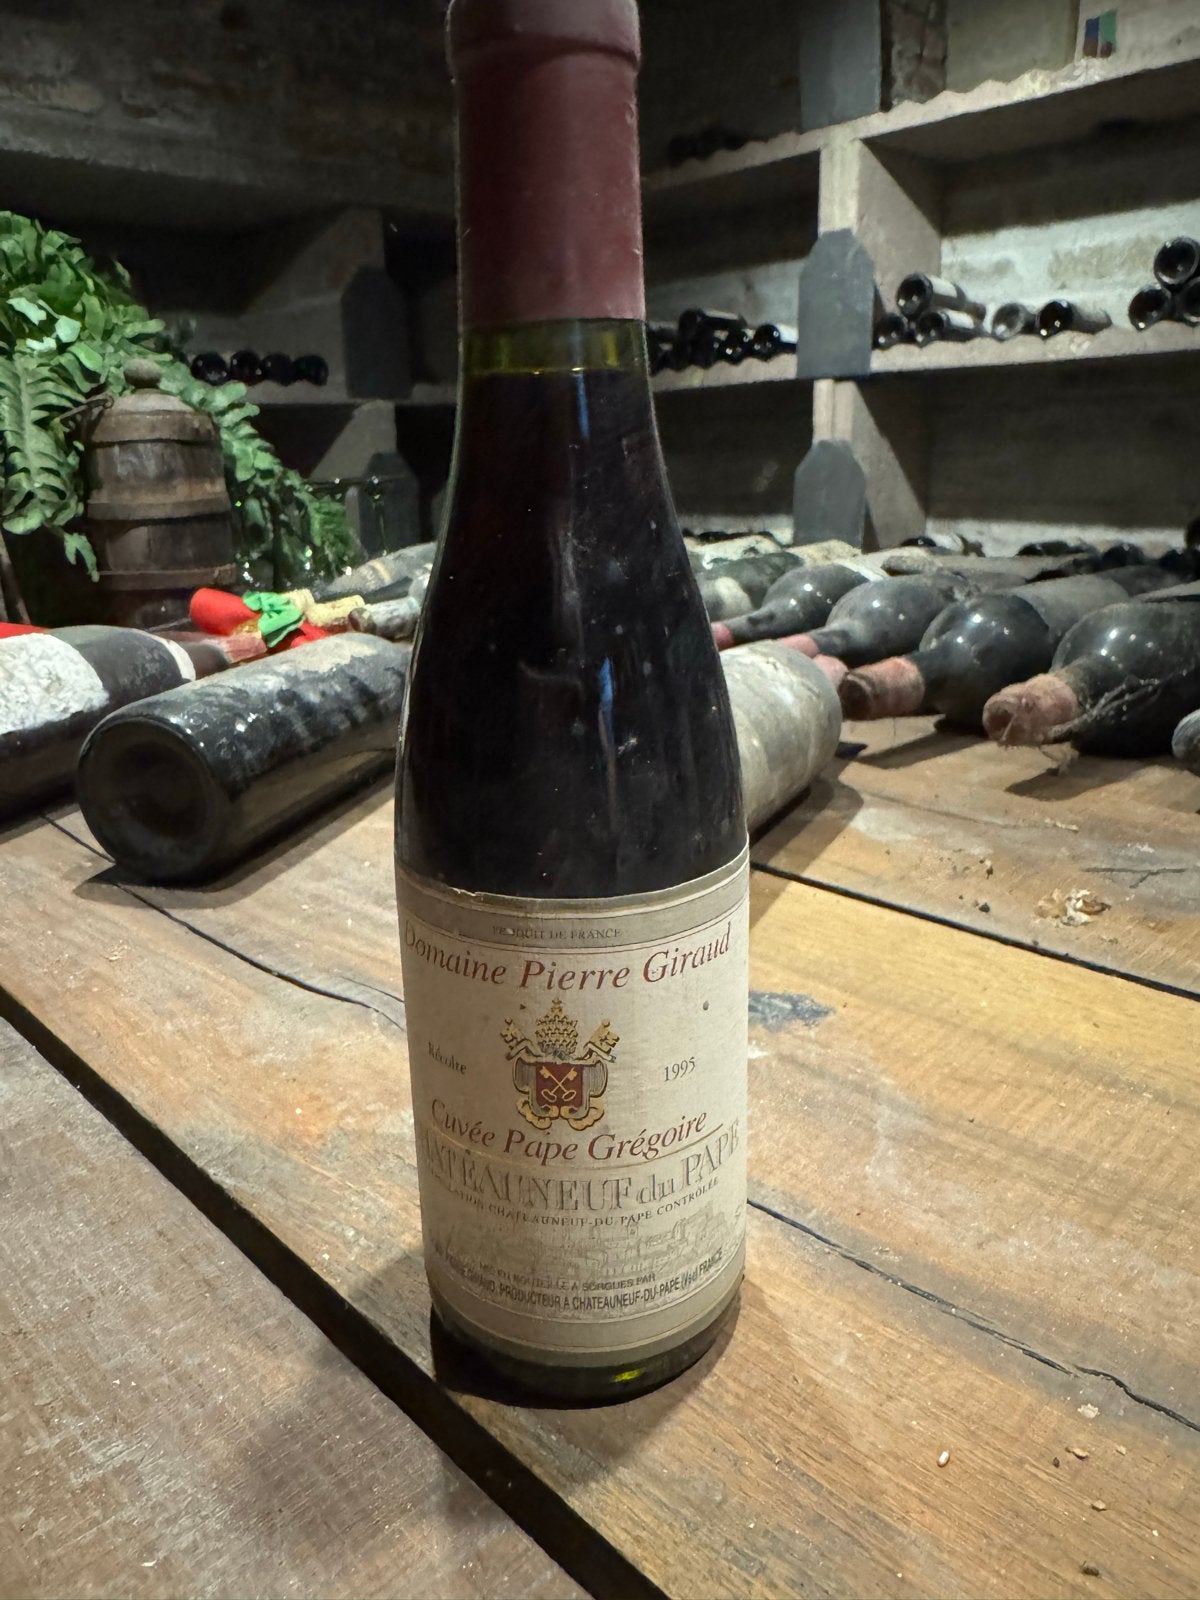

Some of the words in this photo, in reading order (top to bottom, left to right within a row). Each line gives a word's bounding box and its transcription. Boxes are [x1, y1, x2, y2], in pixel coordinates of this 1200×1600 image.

[404, 918, 507, 985] Domaine
[519, 959, 631, 990] Pierre
[643, 920, 732, 983] Giraud
[570, 928, 622, 940] FRANCE
[664, 1056, 696, 1082] 1995
[431, 1098, 496, 1147] Cuvée
[503, 1128, 579, 1166] Pape
[588, 1112, 707, 1160] Grégoire
[636, 1173, 676, 1204] du
[681, 1119, 740, 1190] PAPE
[563, 1296, 570, 1310] A
[572, 1276, 681, 1311] CHATEAUNEUF-DU-PAPE
[699, 1246, 723, 1276] FRANCE
[636, 1273, 656, 1286] PAR
